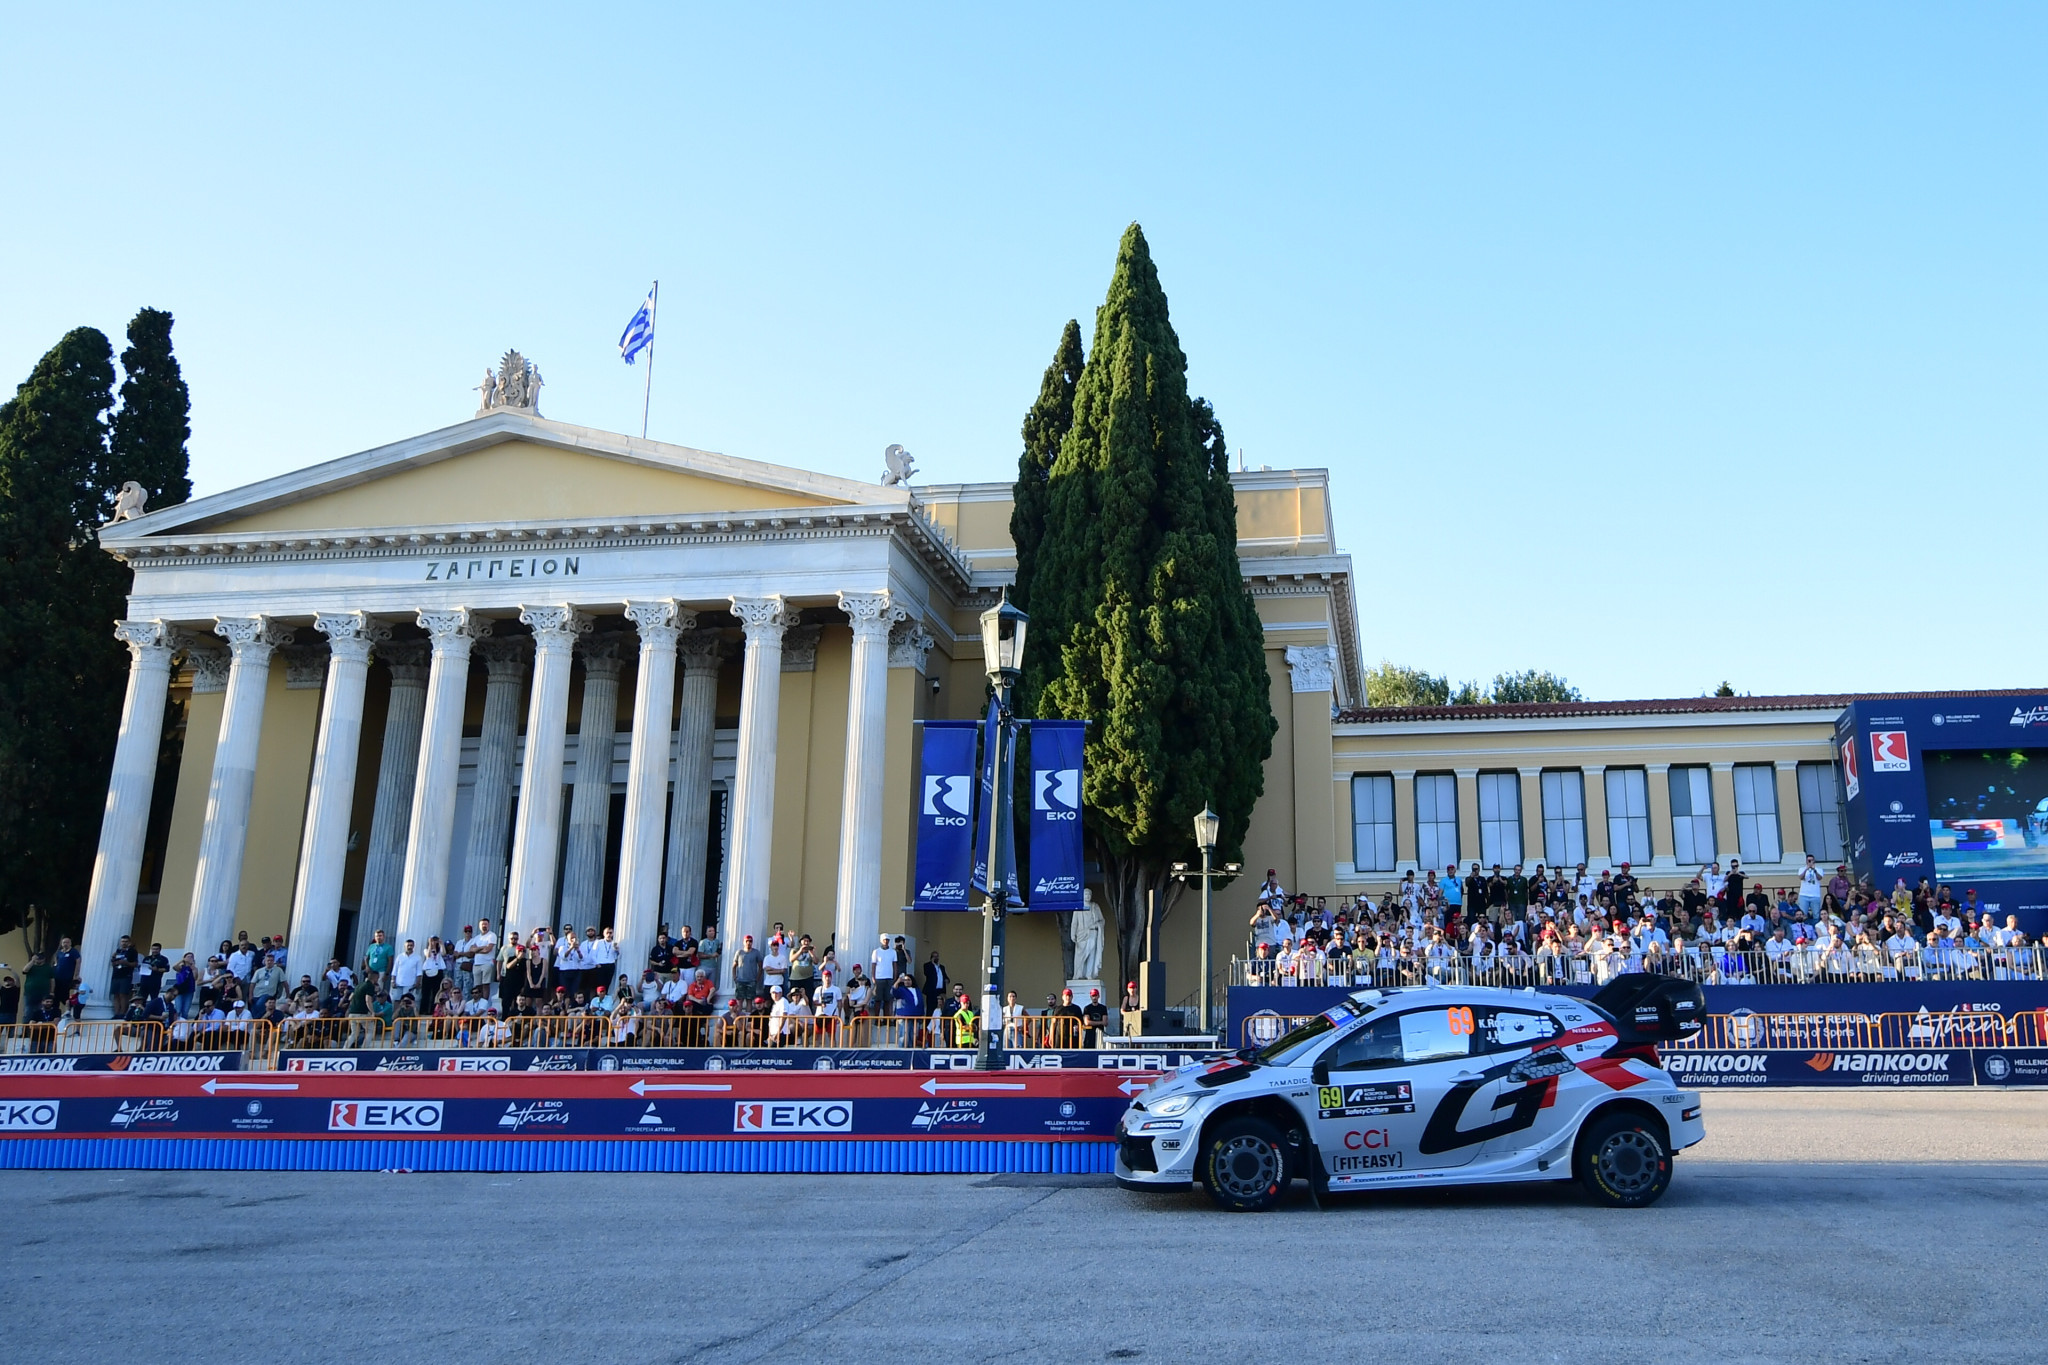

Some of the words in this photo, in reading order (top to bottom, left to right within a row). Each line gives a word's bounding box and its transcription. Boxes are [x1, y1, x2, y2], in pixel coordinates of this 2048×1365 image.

[934, 817, 966, 826] EKO
[1046, 812, 1076, 820] EKO
[1447, 1006, 1475, 1035] 69
[308, 1061, 354, 1071] EKO
[461, 1060, 507, 1071] EKO
[1269, 1078, 1308, 1087] TAMADIC
[1681, 1072, 1720, 1085] driving
[1722, 1073, 1767, 1083] emotion
[1862, 1072, 1900, 1084] driving
[1902, 1072, 1949, 1082] emotion
[1320, 1087, 1342, 1108] 69
[0, 1105, 55, 1125] KO
[365, 1105, 440, 1126] EKO
[771, 1106, 849, 1126] EKO
[1345, 1107, 1389, 1115] SafetyCulture
